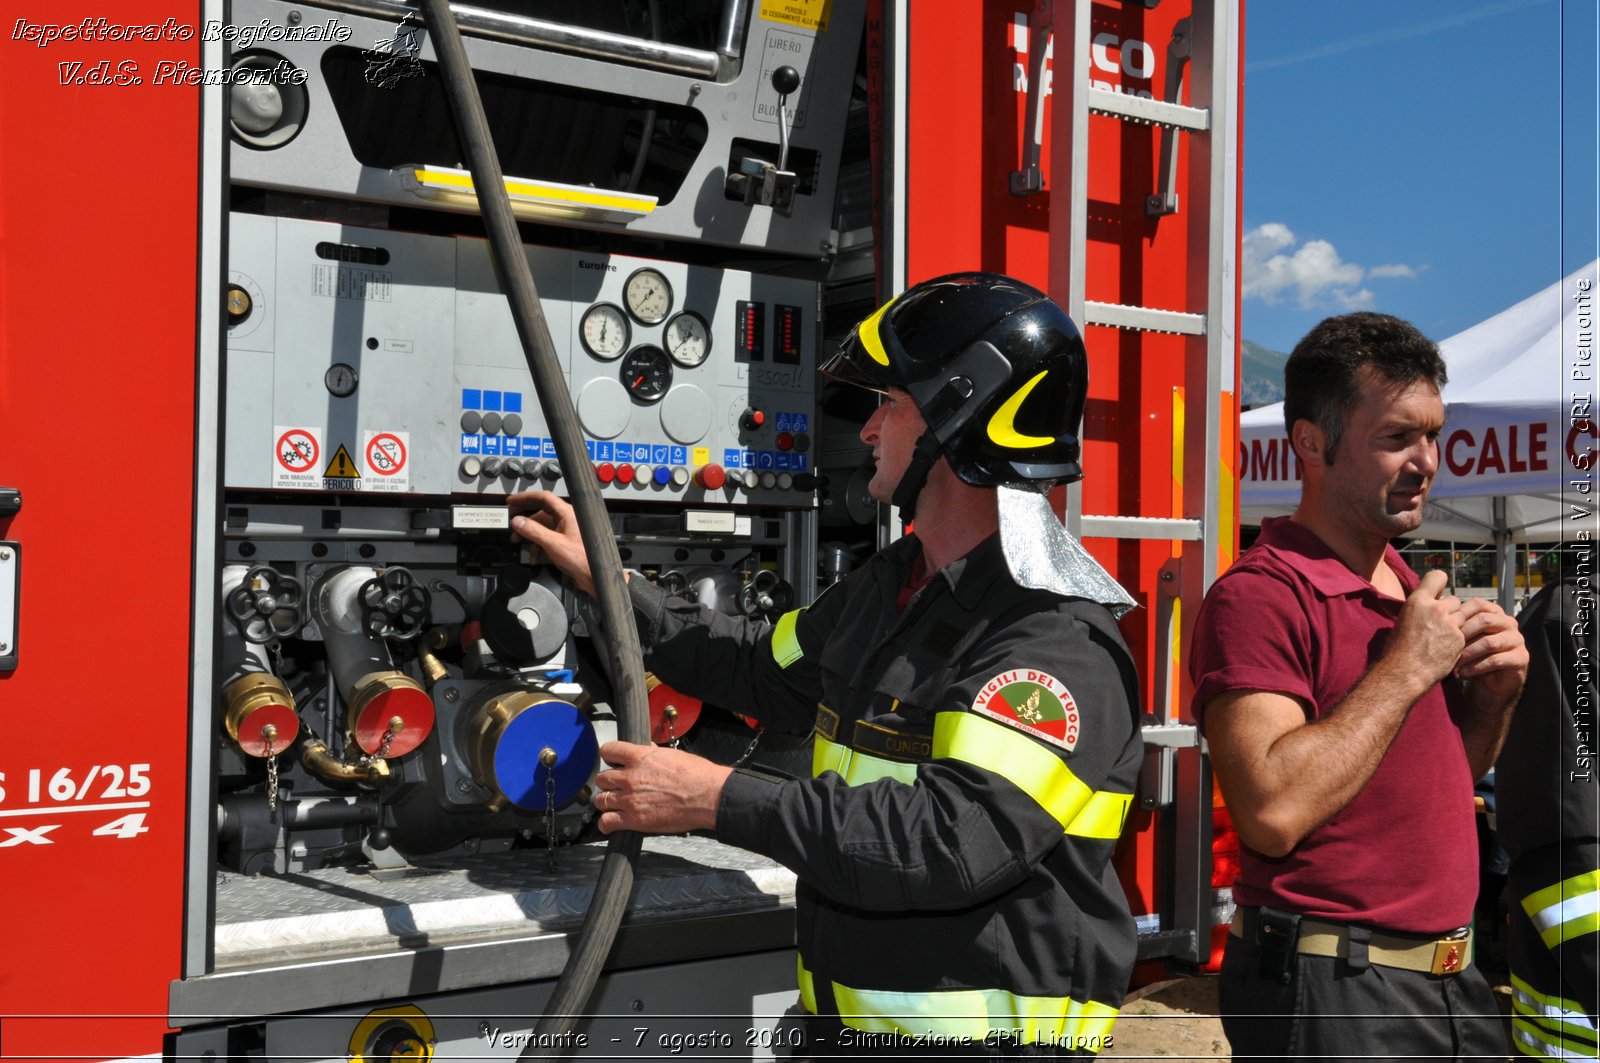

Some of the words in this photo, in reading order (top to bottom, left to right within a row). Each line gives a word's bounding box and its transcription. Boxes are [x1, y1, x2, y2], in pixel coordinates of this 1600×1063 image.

[769, 37, 802, 53] LIBERO
[1014, 12, 1155, 80] ICO
[758, 104, 805, 121] BLOATO
[1438, 423, 1548, 477] CALE
[322, 479, 362, 490] PERICOLO
[976, 671, 1018, 705] VIGILI
[1027, 671, 1054, 689] DEL
[1059, 692, 1078, 744] FUOCO
[886, 737, 930, 756] CUNEO
[28, 763, 151, 803] 16/25
[92, 812, 150, 839] 4
